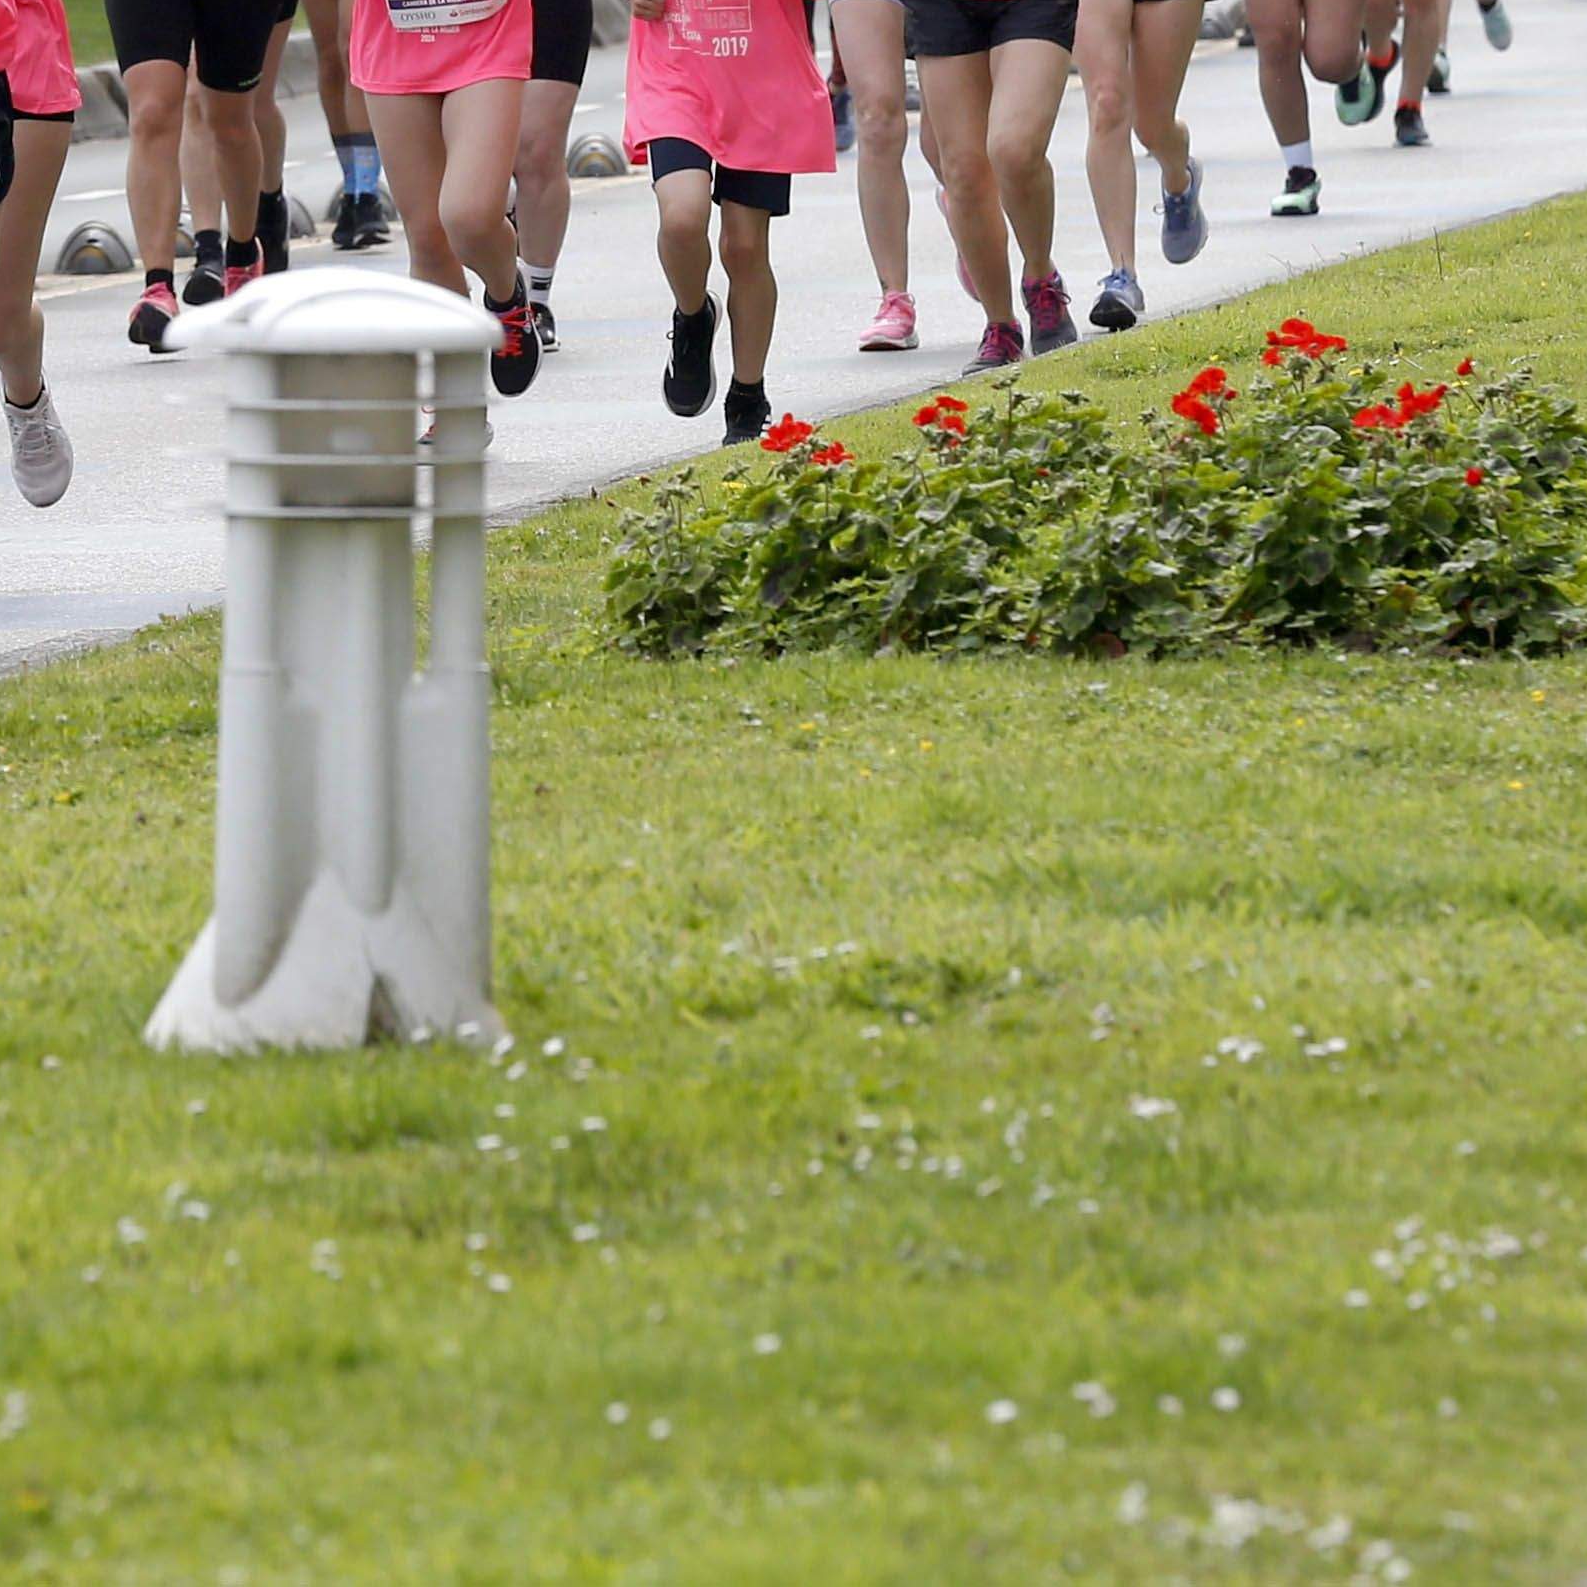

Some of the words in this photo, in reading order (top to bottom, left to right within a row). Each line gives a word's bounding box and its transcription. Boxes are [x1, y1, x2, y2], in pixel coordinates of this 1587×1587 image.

[402, 0, 428, 7] CARRERA
[400, 11, 436, 22] OYSHO
[712, 36, 748, 57] 2019
